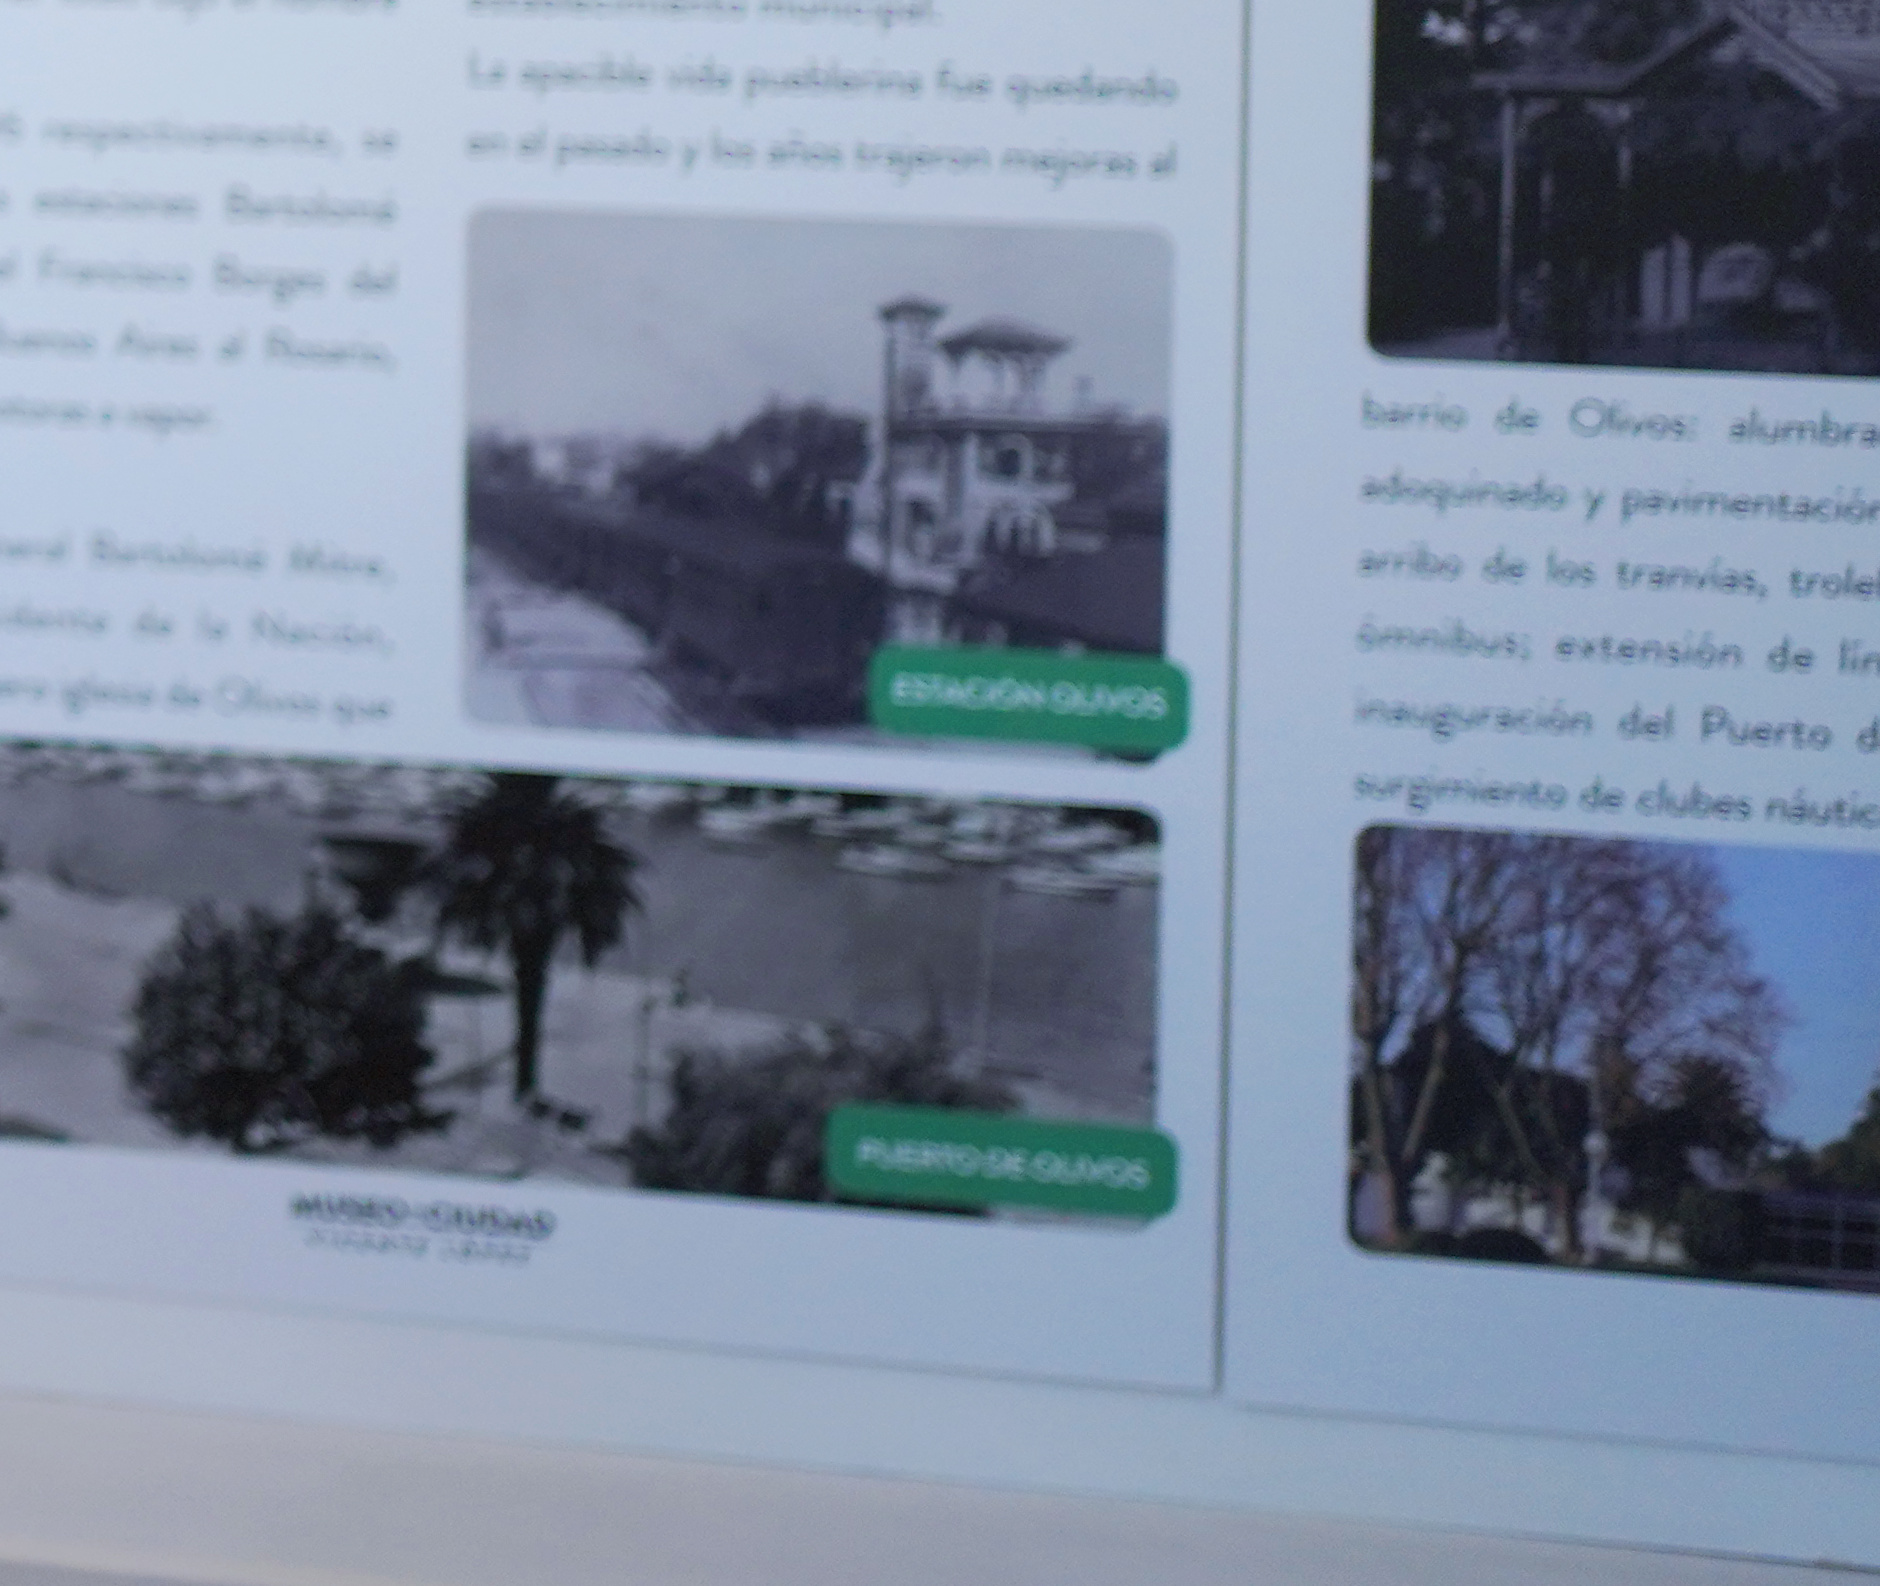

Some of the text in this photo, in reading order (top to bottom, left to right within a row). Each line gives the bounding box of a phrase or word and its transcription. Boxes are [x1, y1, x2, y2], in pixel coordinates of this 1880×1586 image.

[465, 47, 1181, 112] La apacible vida pueblerina fue quedando
[464, 123, 1179, 192] en el pasado y los años trajeron mejoras al
[1359, 388, 1470, 433] barrio
[1493, 395, 1543, 436] de
[1358, 465, 1571, 518] adoquinado
[1582, 486, 1608, 526] y
[1356, 539, 1466, 583] arribo
[1480, 543, 1529, 586] de
[1545, 546, 1598, 588] los
[1614, 555, 1770, 603] tranvías,
[1354, 611, 1533, 664] ómnibus;
[1553, 629, 1745, 670] extensión
[1765, 634, 1817, 675] de
[892, 671, 1169, 721] ESTACIÓN OLIVOS
[1352, 685, 1596, 744] inauguración
[1615, 701, 1677, 742] del
[1698, 703, 1835, 751] Puerto
[1352, 765, 1569, 814] surgimiento
[1577, 774, 1626, 814] de
[1634, 777, 1754, 822] clubes
[854, 1136, 1151, 1193] PUERTO DE OLIVOS
